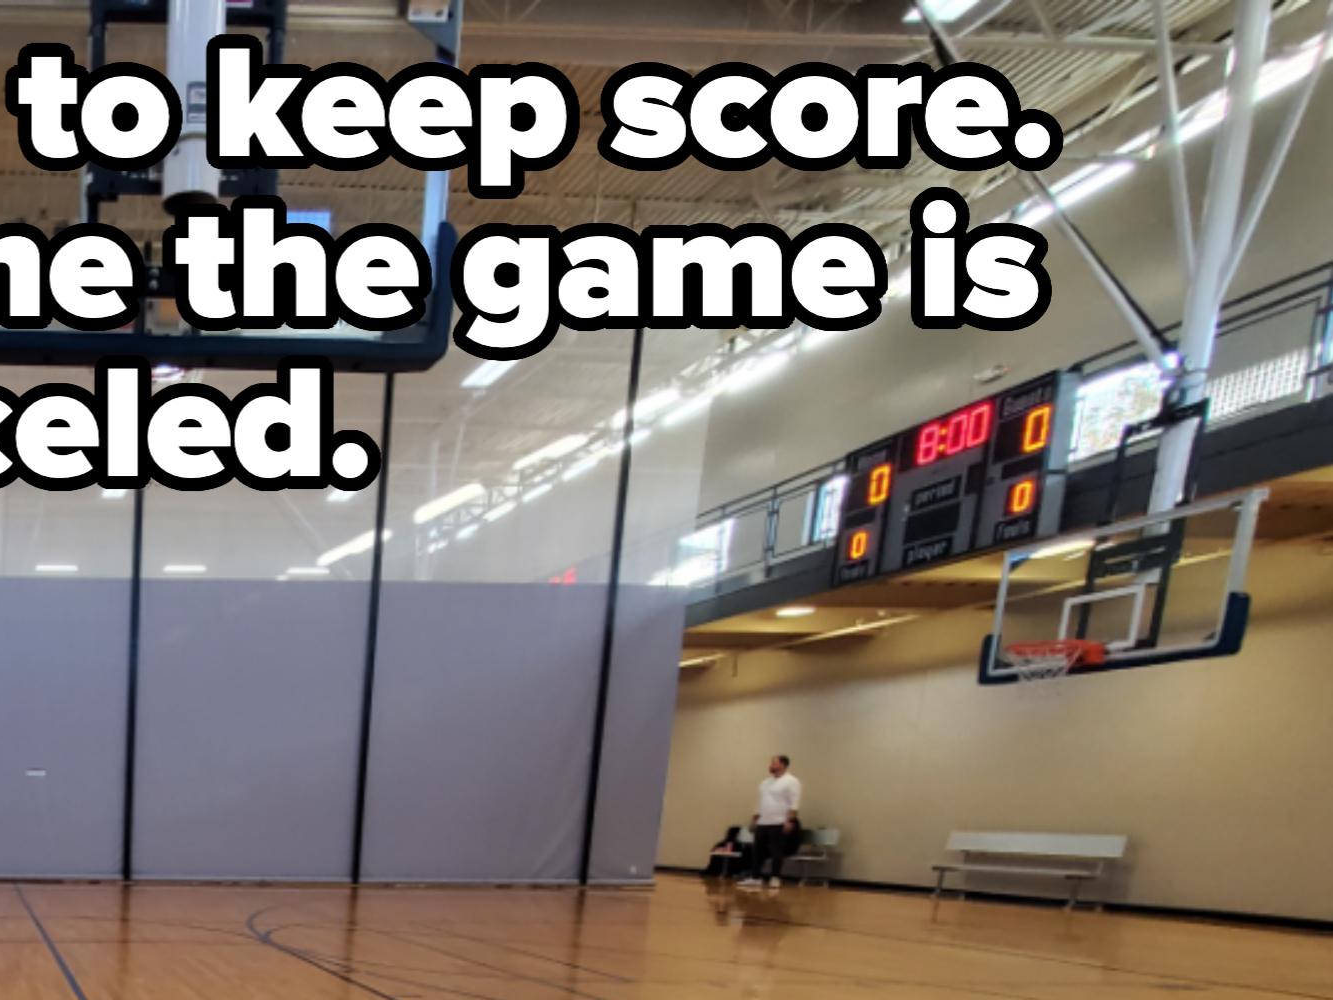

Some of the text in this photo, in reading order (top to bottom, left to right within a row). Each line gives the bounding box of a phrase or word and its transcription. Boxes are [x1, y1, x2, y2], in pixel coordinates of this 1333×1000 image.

[915, 402, 994, 466] 8:00
[1023, 404, 1052, 453] 0
[868, 464, 892, 505] 0
[1012, 480, 1035, 513] 0
[851, 531, 868, 559] 0
